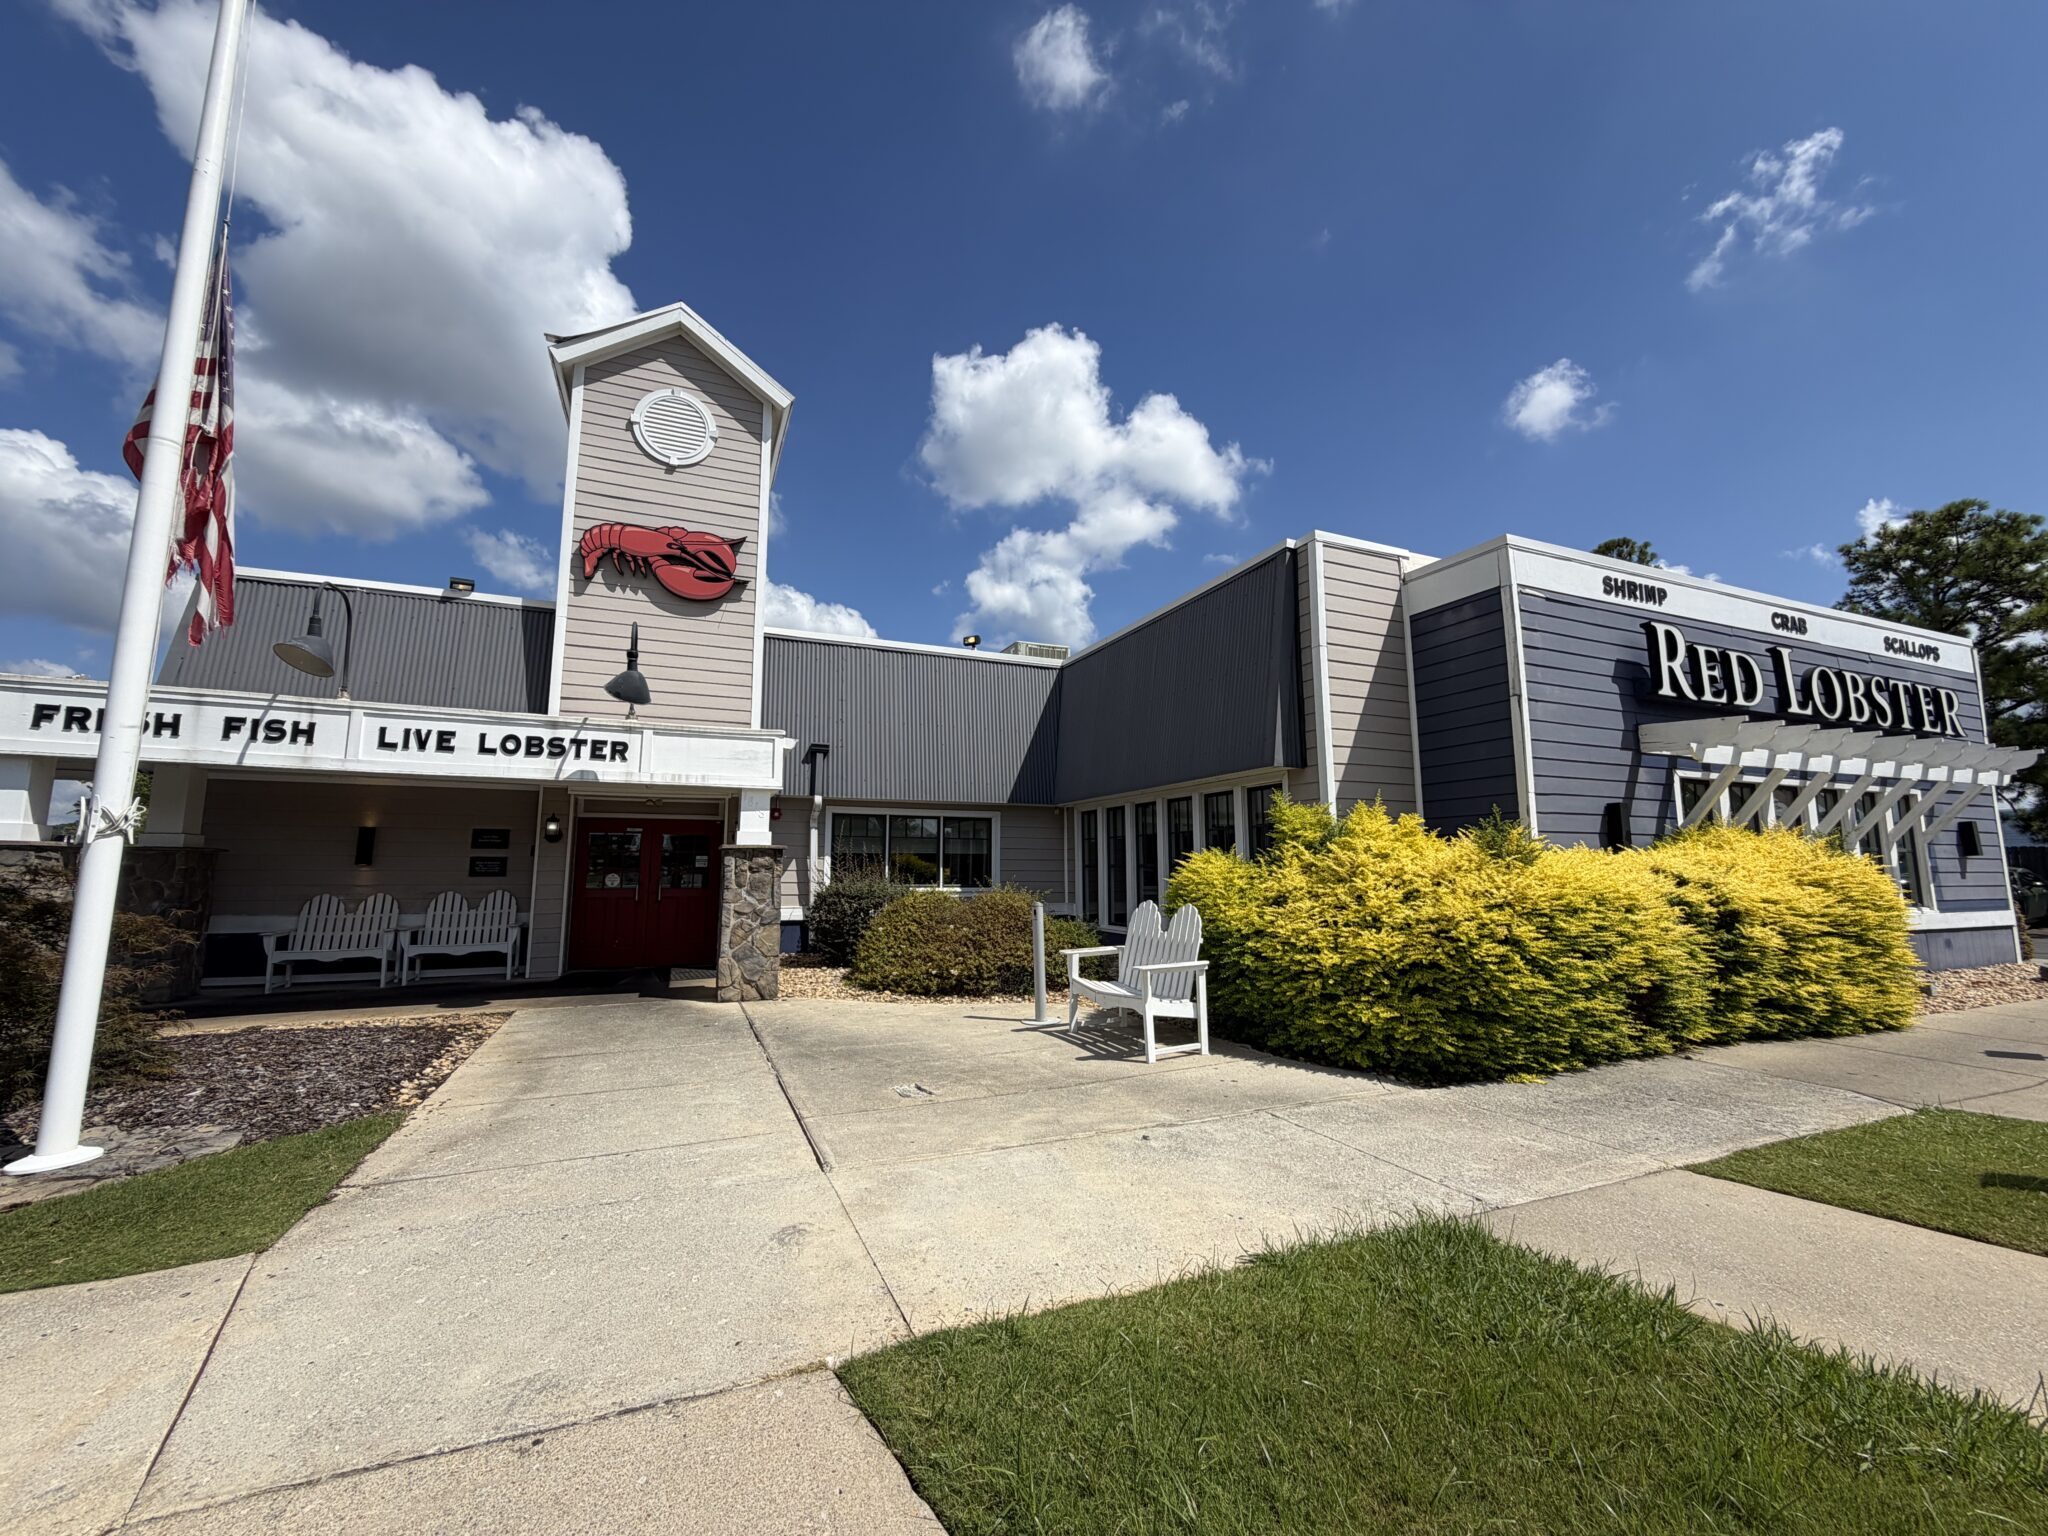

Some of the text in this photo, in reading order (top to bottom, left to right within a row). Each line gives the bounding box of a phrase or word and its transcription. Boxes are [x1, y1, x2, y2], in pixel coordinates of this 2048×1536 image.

[1602, 576, 1668, 607] SHRIMP
[1771, 612, 1808, 636] CRAB
[1883, 636, 1941, 662] SCALLOPS
[1645, 621, 1967, 738] RED LOBSTER
[222, 716, 317, 746] FISH
[378, 726, 630, 762] LIVE LOBSTER
